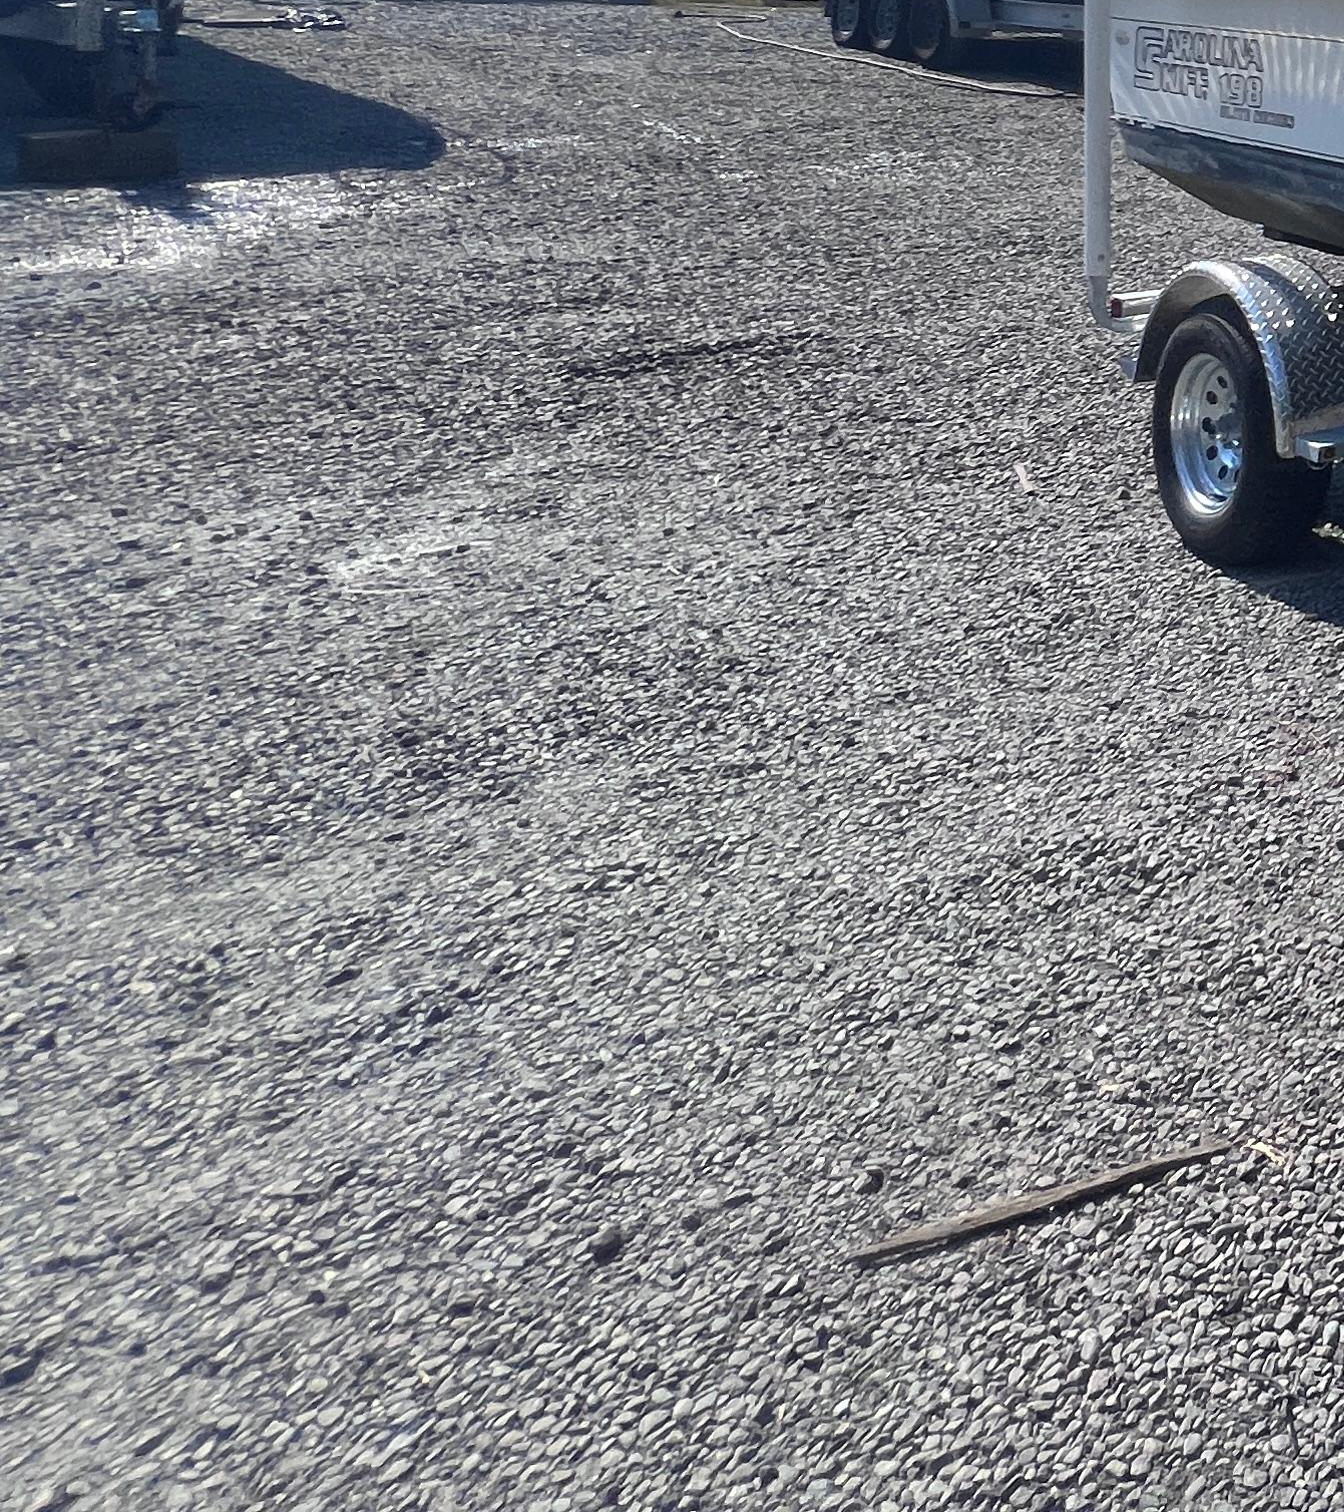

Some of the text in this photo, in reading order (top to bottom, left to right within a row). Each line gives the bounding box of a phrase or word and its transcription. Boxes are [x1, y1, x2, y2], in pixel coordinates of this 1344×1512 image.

[1133, 44, 1264, 109] SKIFF 198
[1135, 25, 1265, 74] CAROLINA
